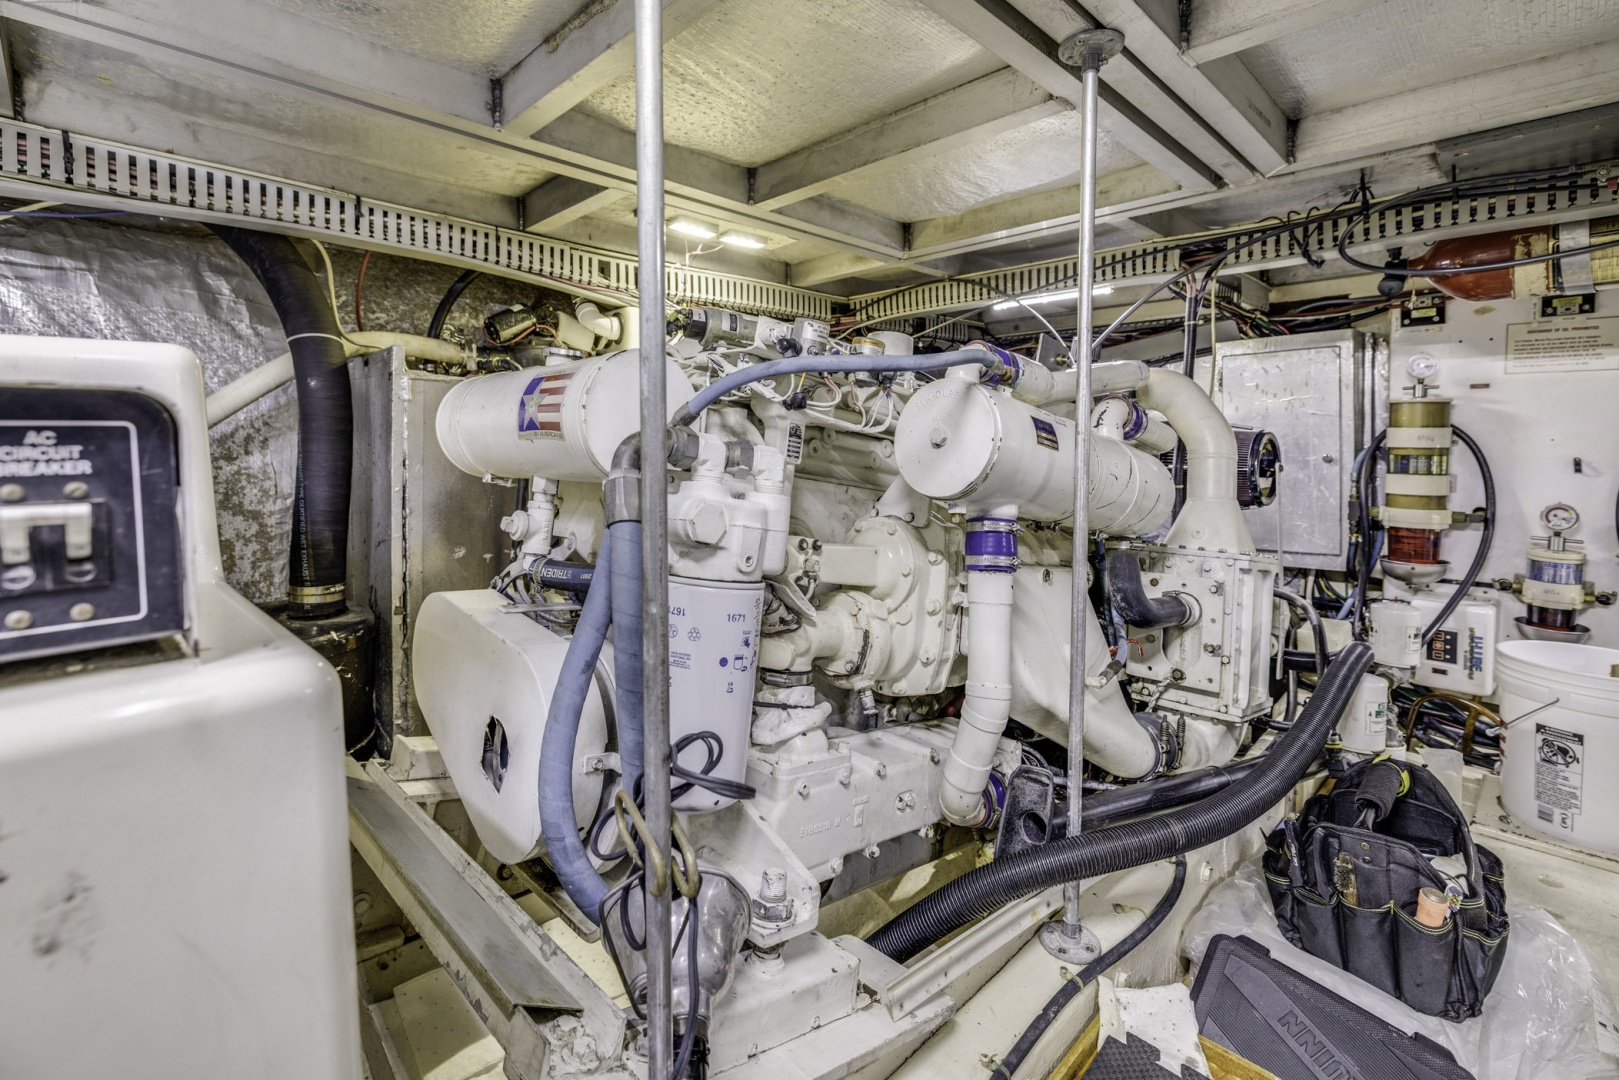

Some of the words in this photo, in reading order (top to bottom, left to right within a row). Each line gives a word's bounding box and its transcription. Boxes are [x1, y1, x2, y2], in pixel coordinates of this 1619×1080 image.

[22, 429, 58, 446] AC
[0, 444, 84, 462] CIRCUIT
[301, 550, 310, 581] EXHAUST
[540, 567, 568, 579] TRIDEN
[726, 613, 746, 623] 1671
